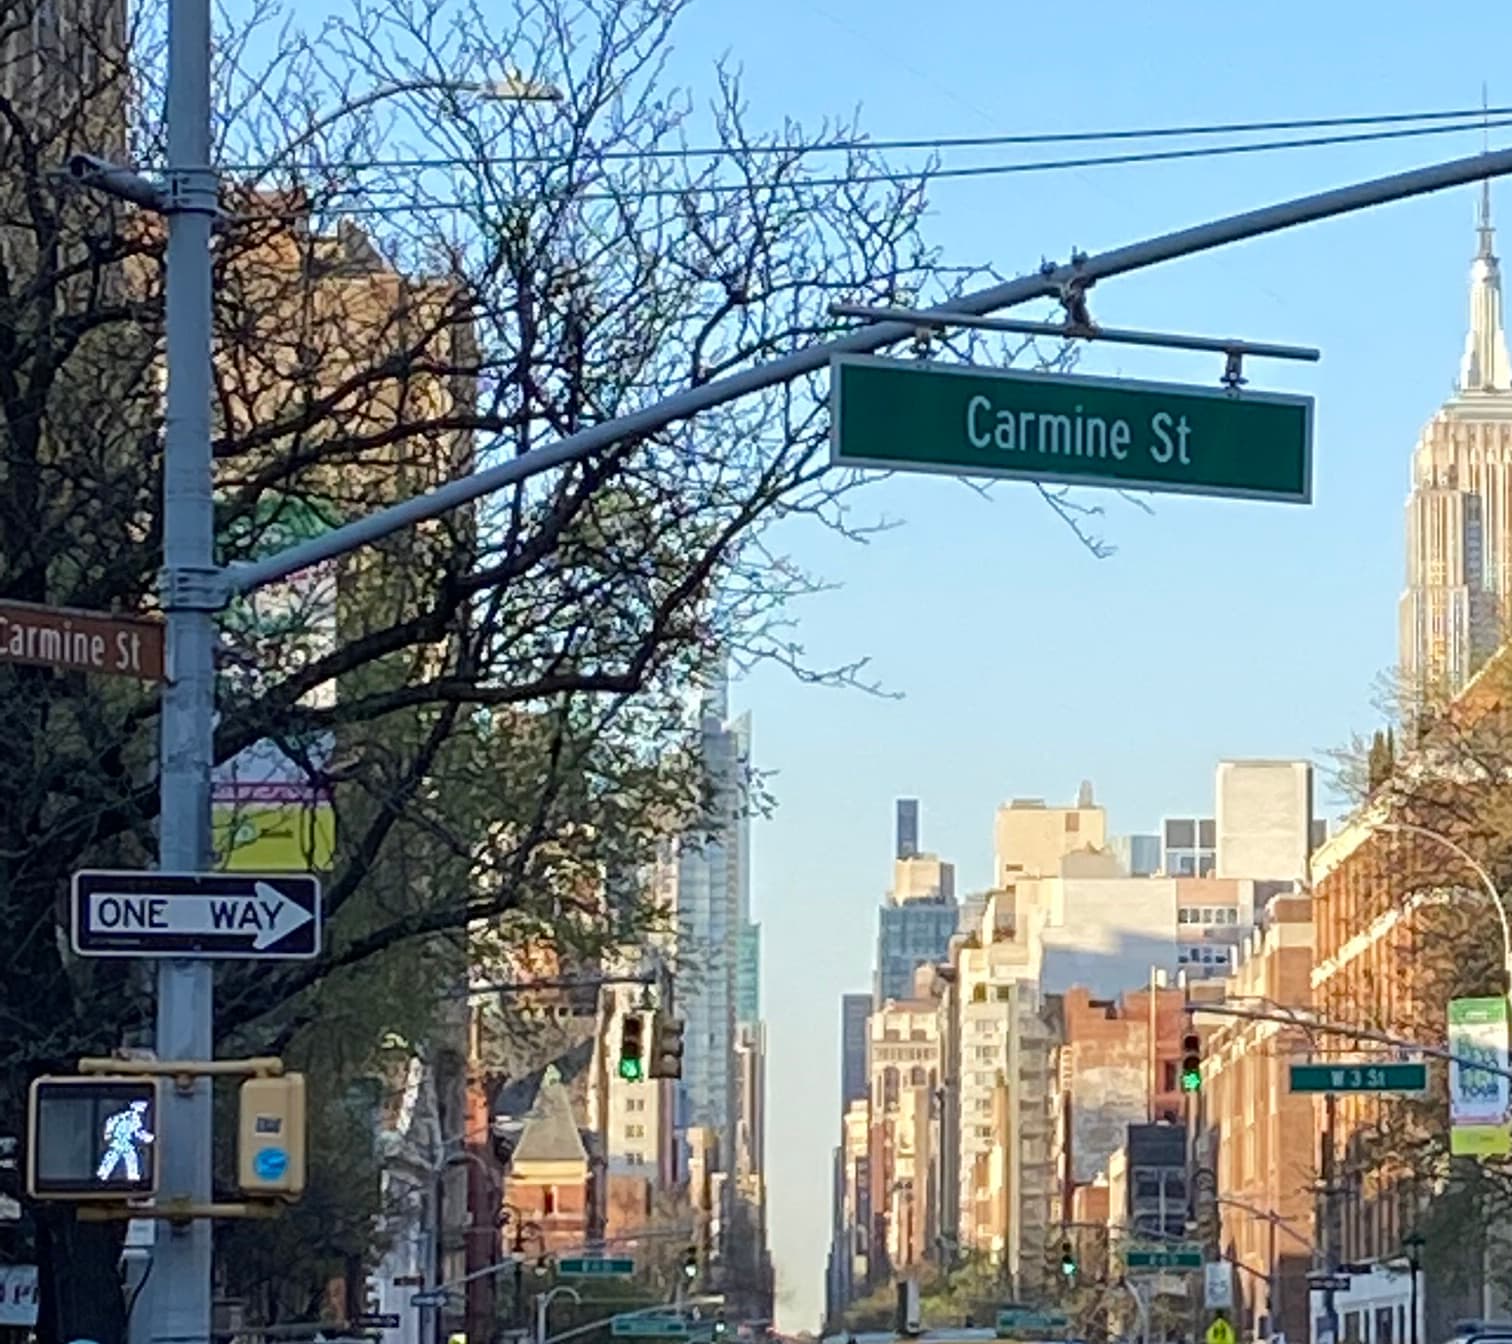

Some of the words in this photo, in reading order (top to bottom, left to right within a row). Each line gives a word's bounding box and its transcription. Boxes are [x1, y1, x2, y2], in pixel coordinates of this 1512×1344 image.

[967, 395, 1131, 460] Carmine
[1150, 412, 1191, 465] St
[115, 631, 141, 670] St
[98, 897, 168, 929] ONE
[209, 900, 285, 930] WAY
[1330, 1069, 1345, 1087] W
[1350, 1070, 1361, 1087] 3
[1366, 1067, 1386, 1088] St
